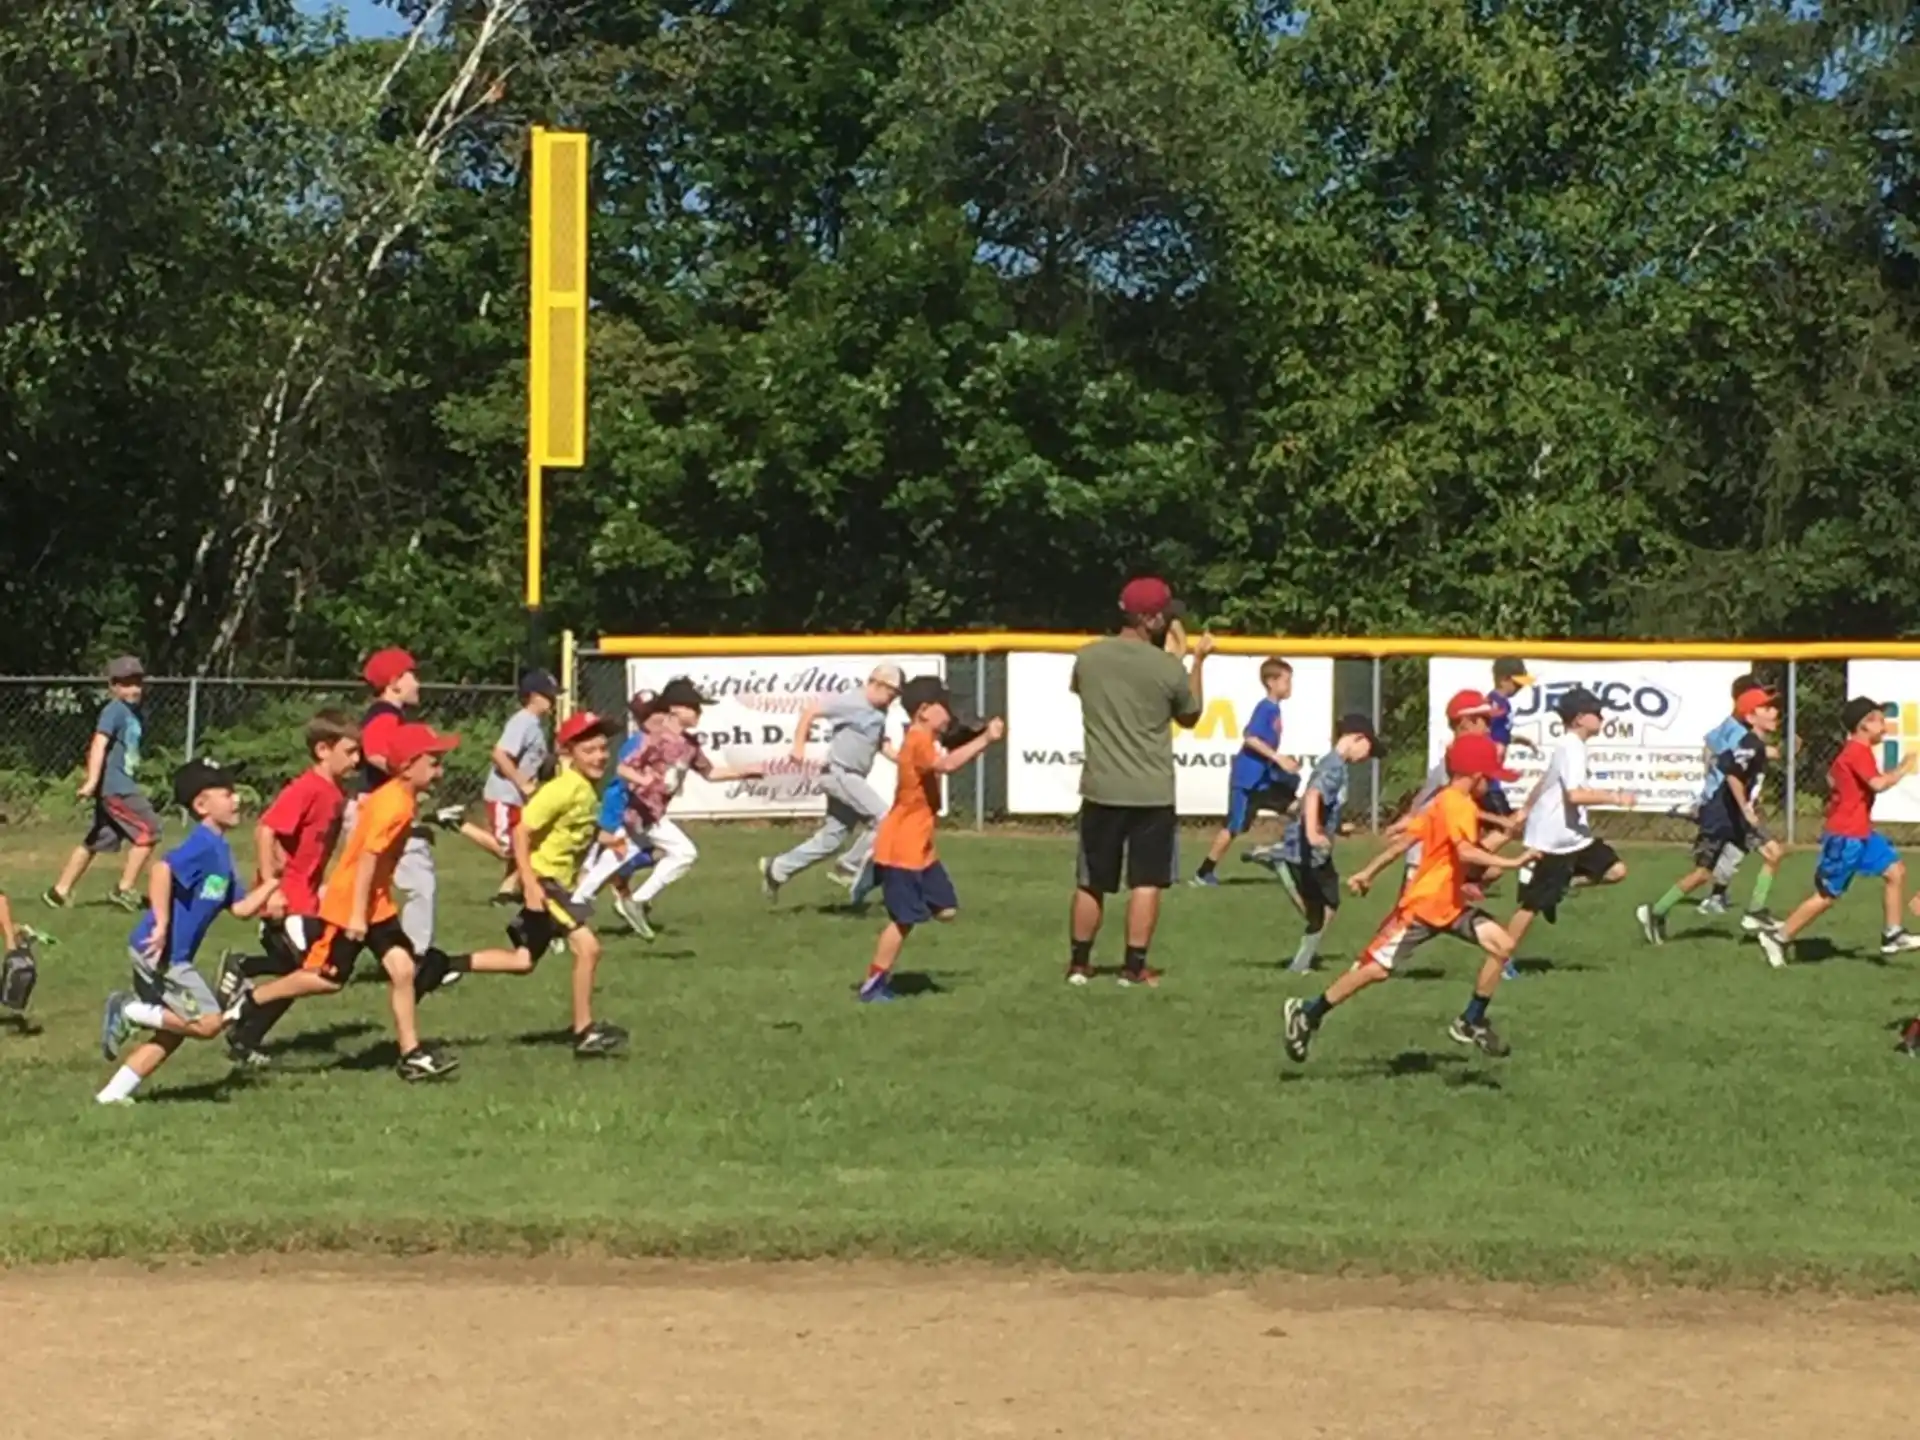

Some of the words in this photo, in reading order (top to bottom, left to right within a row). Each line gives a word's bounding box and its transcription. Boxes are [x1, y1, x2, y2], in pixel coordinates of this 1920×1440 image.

[695, 669, 779, 696] istrict
[784, 666, 864, 694] Attor
[1022, 750, 1085, 765] WAS
